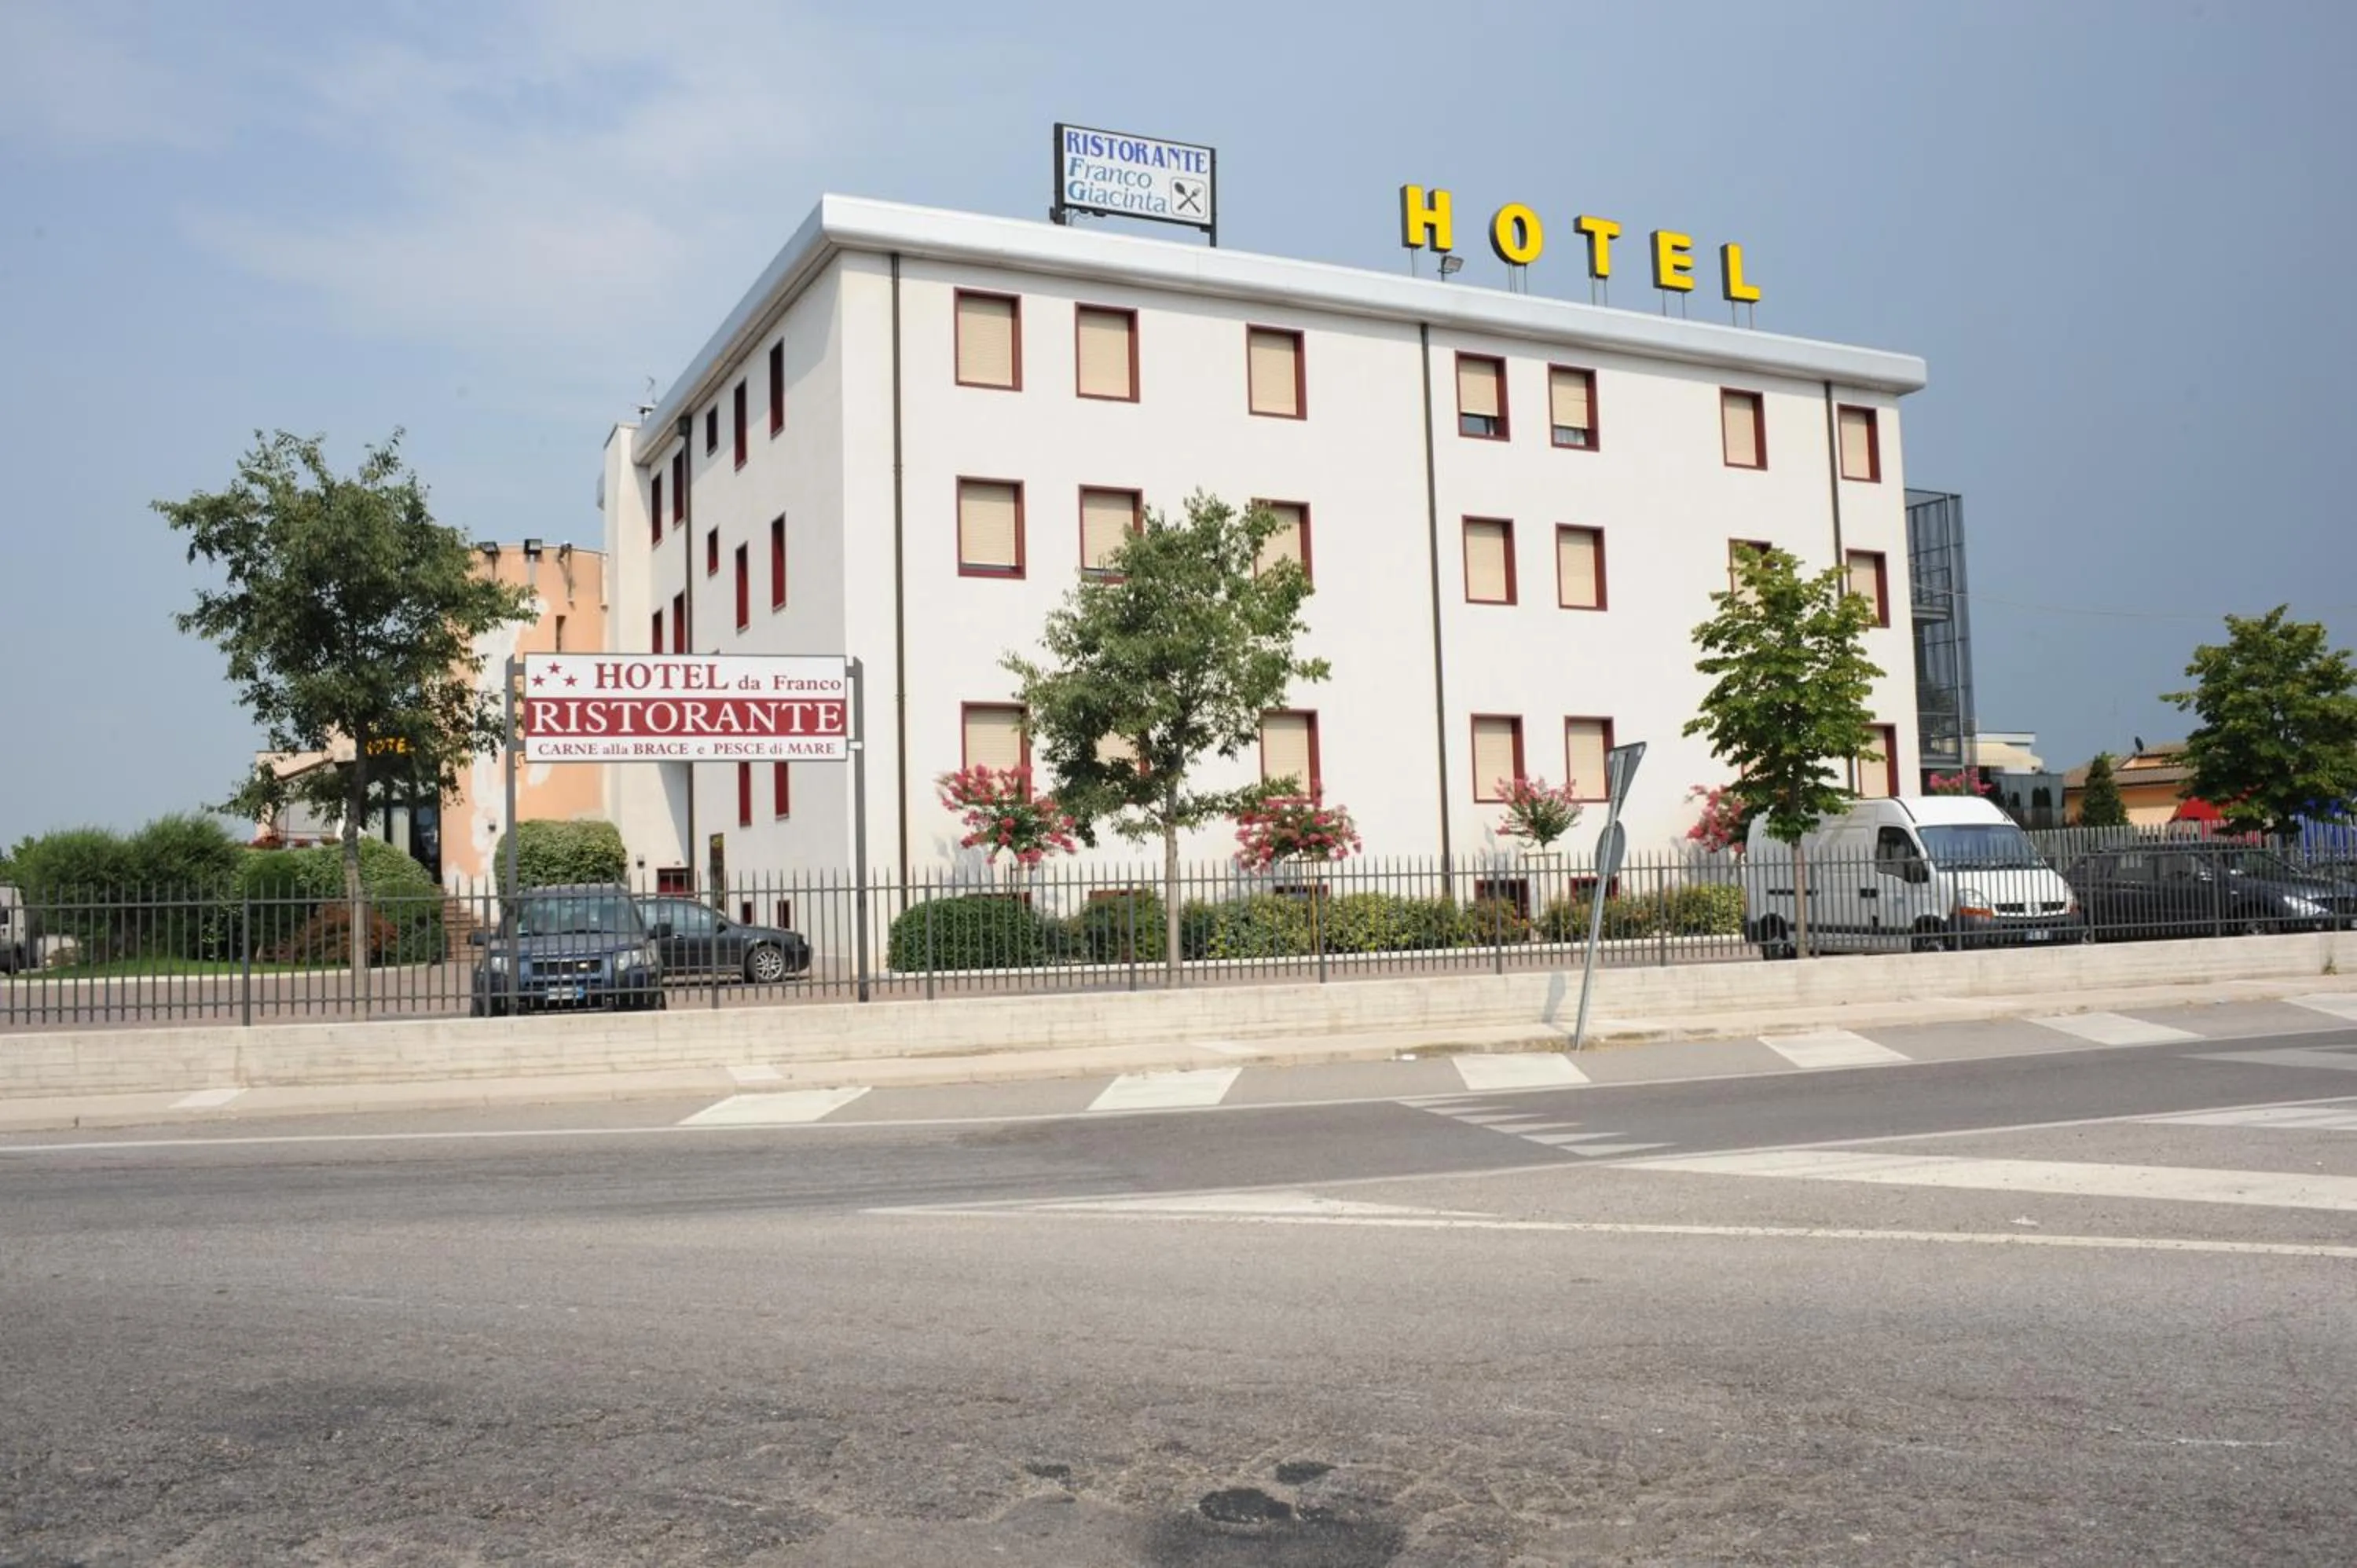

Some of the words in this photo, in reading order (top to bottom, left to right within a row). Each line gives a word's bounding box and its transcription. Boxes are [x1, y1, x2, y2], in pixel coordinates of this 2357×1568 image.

[1066, 130, 1208, 174] RISTORANTE
[1068, 157, 1152, 189] Franco
[1068, 180, 1167, 213] Giacinta
[1399, 184, 1761, 303] HOTEL
[594, 663, 729, 690] HOTEL
[738, 675, 761, 691] da
[773, 675, 842, 691] Franco
[530, 702, 843, 733] RISTORANTE
[538, 743, 598, 756] CARNE
[603, 742, 629, 755] alla
[633, 743, 689, 755] BRACE
[697, 746, 705, 755] e
[713, 743, 766, 755] PESCE
[769, 742, 783, 755] di
[787, 743, 836, 755] MARE
